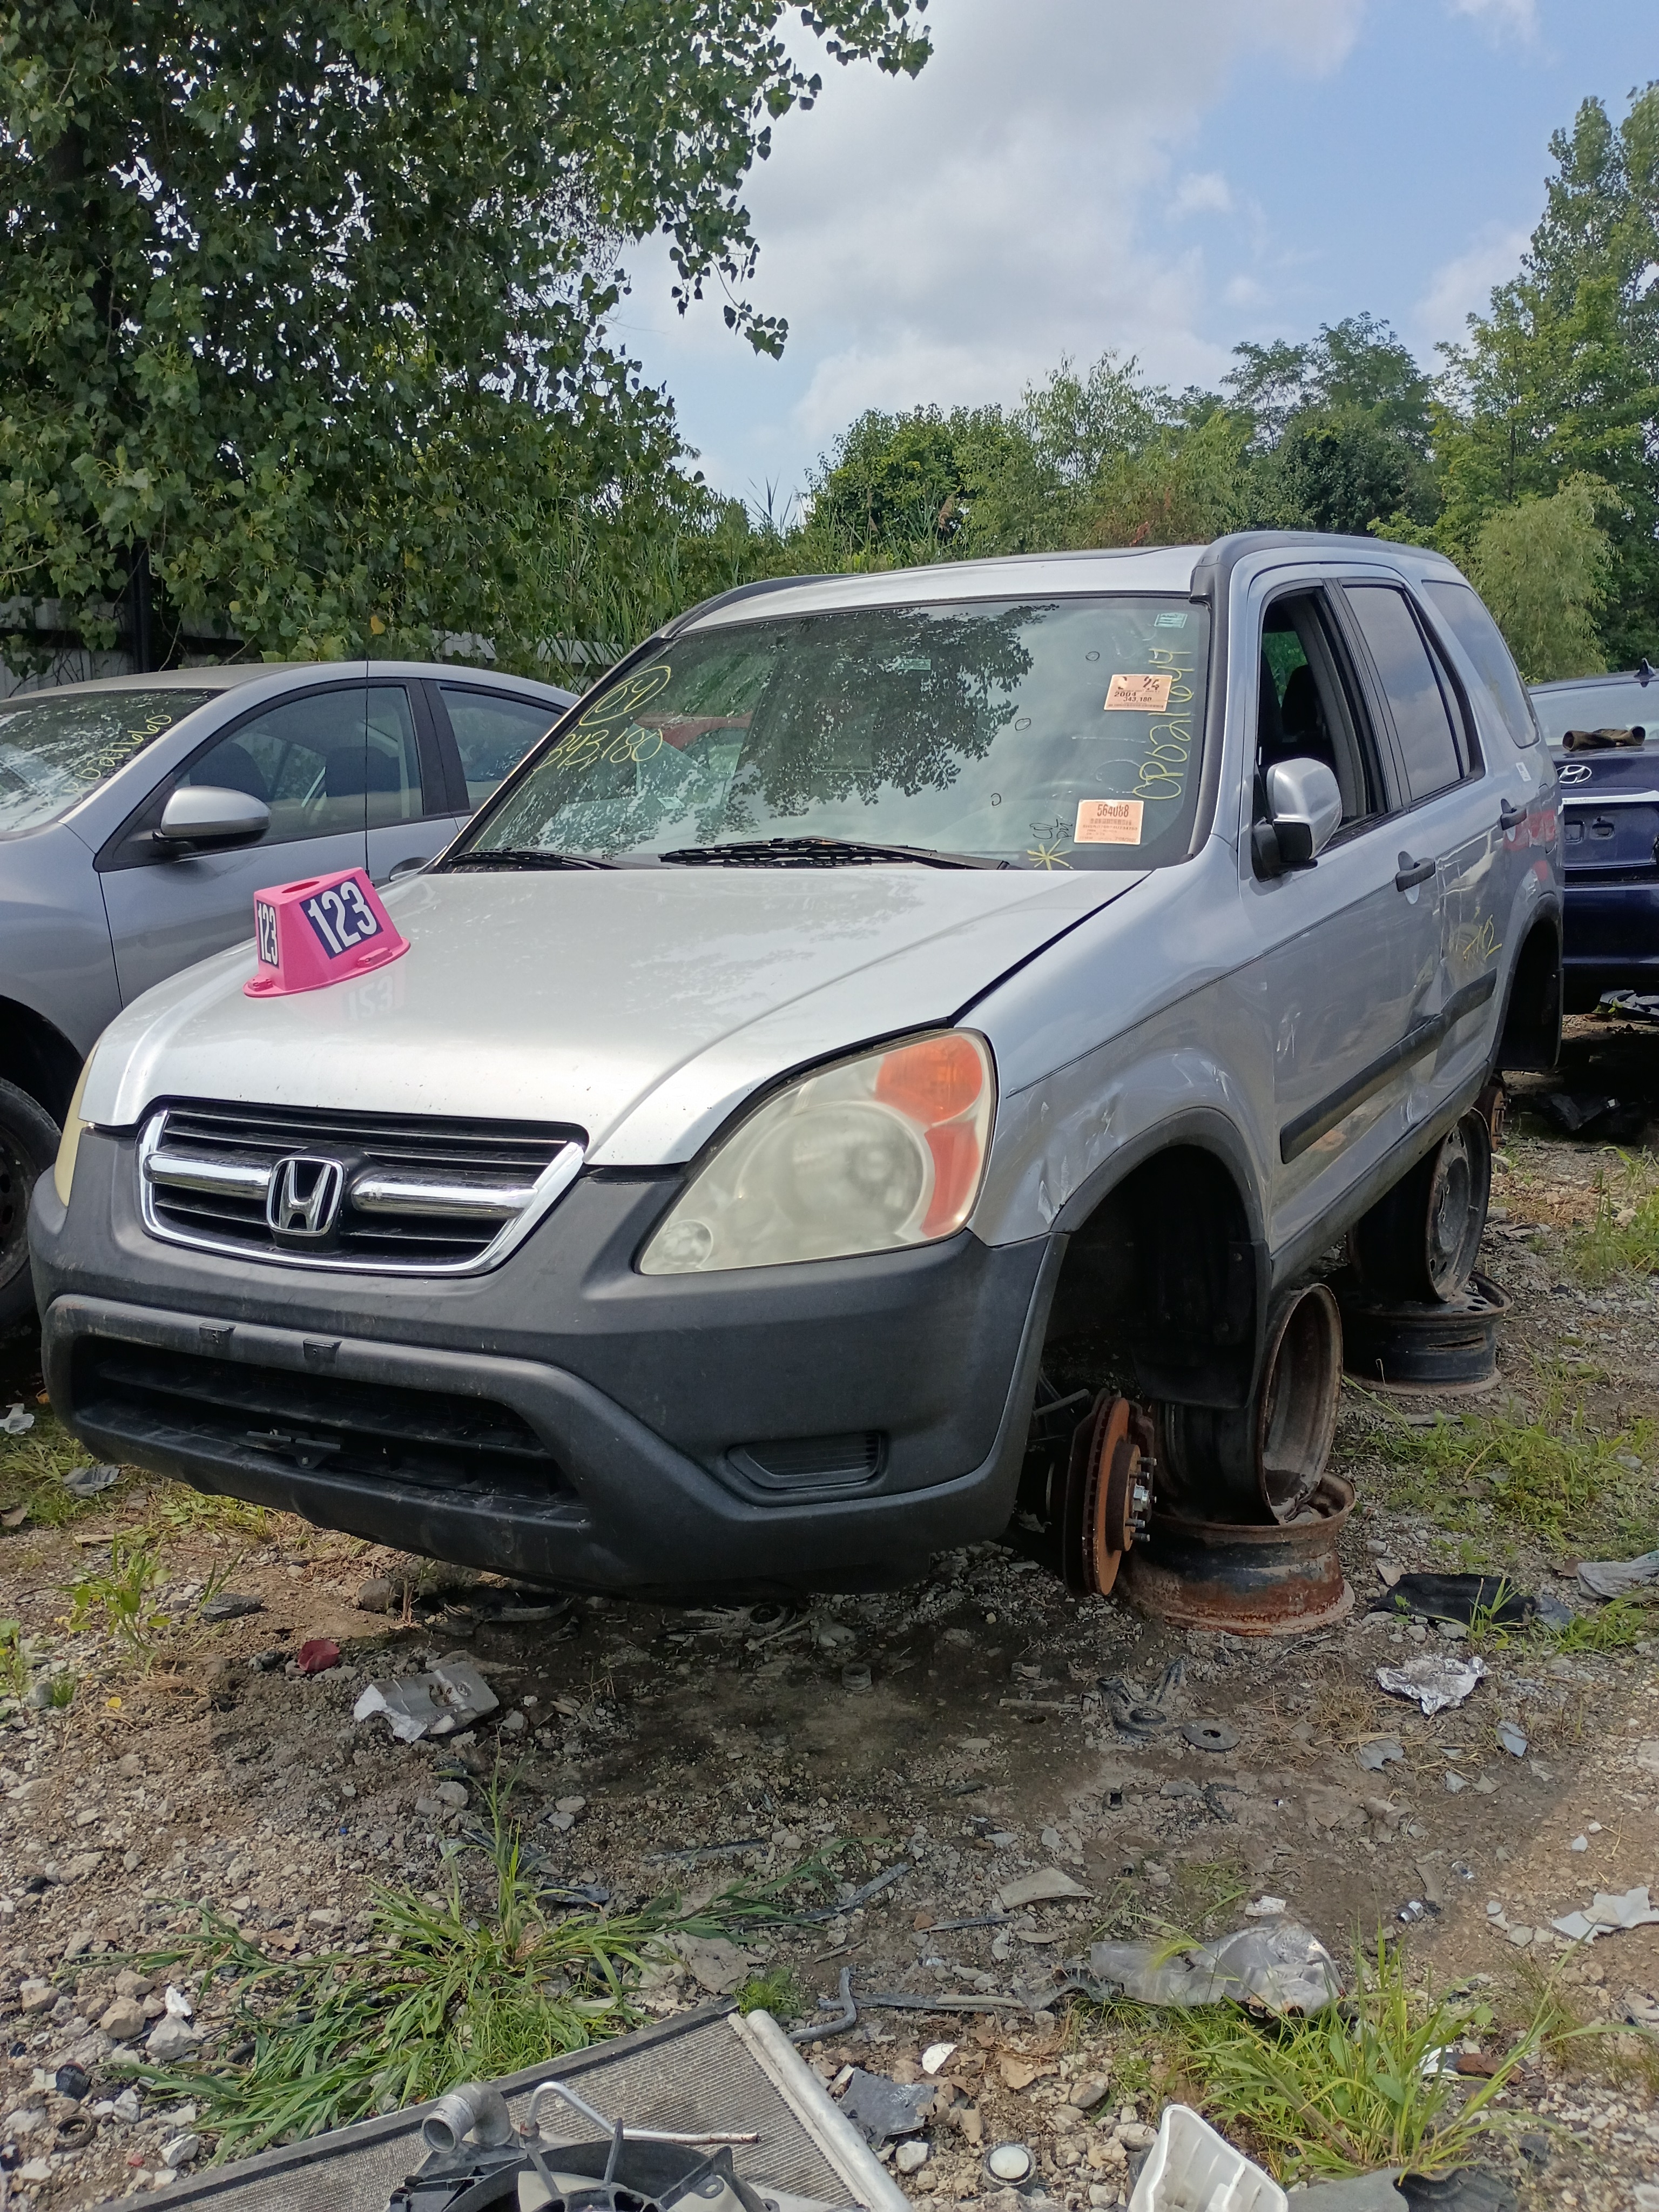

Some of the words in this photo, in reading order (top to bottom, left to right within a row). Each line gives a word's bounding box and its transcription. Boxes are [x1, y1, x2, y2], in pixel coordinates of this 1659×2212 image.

[1097, 804, 1129, 817] 564088
[258, 903, 278, 965] 123
[308, 881, 377, 954] 123
